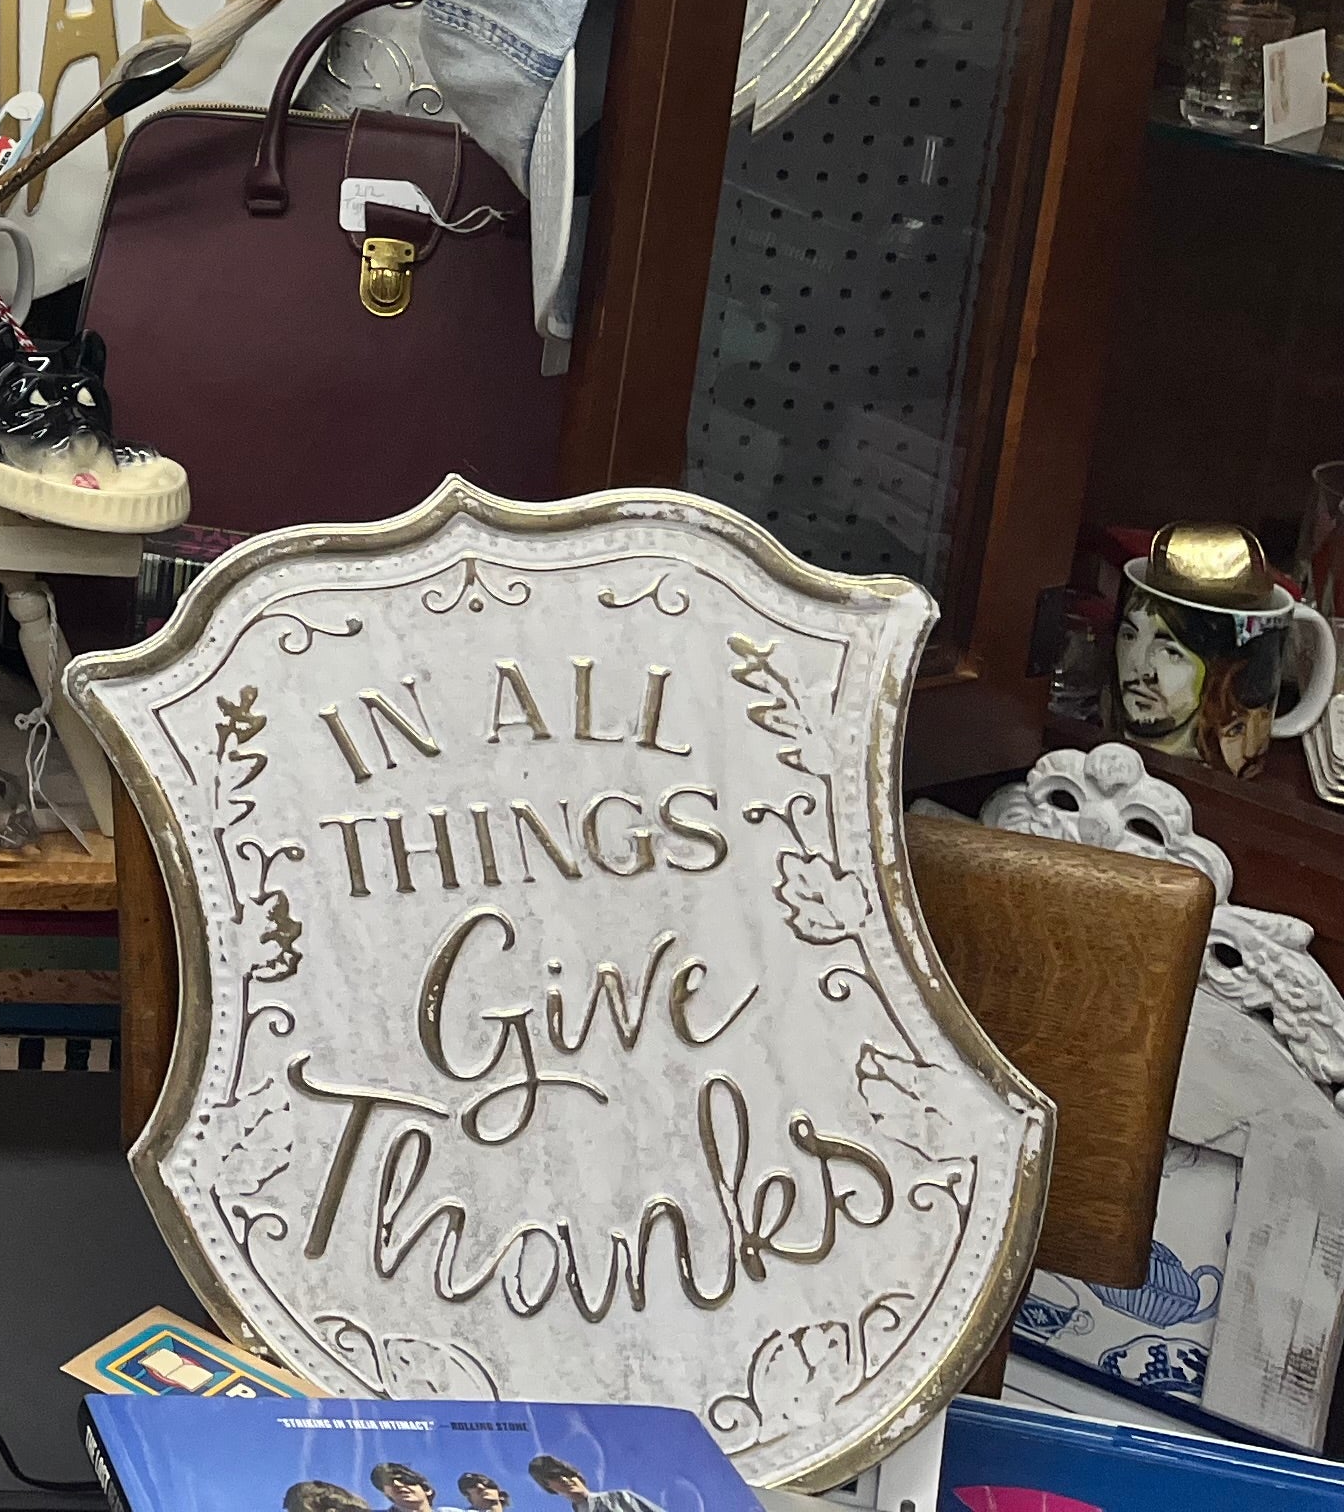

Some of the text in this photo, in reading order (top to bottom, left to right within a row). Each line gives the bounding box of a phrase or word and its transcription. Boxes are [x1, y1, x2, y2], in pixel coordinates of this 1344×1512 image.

[319, 654, 693, 784] IN ALL
[319, 786, 730, 899] THINGS
[417, 906, 759, 1148] Give
[289, 1051, 895, 1322] Thanks
[333, 1418, 344, 1430] IN
[346, 1419, 377, 1431] THEIR
